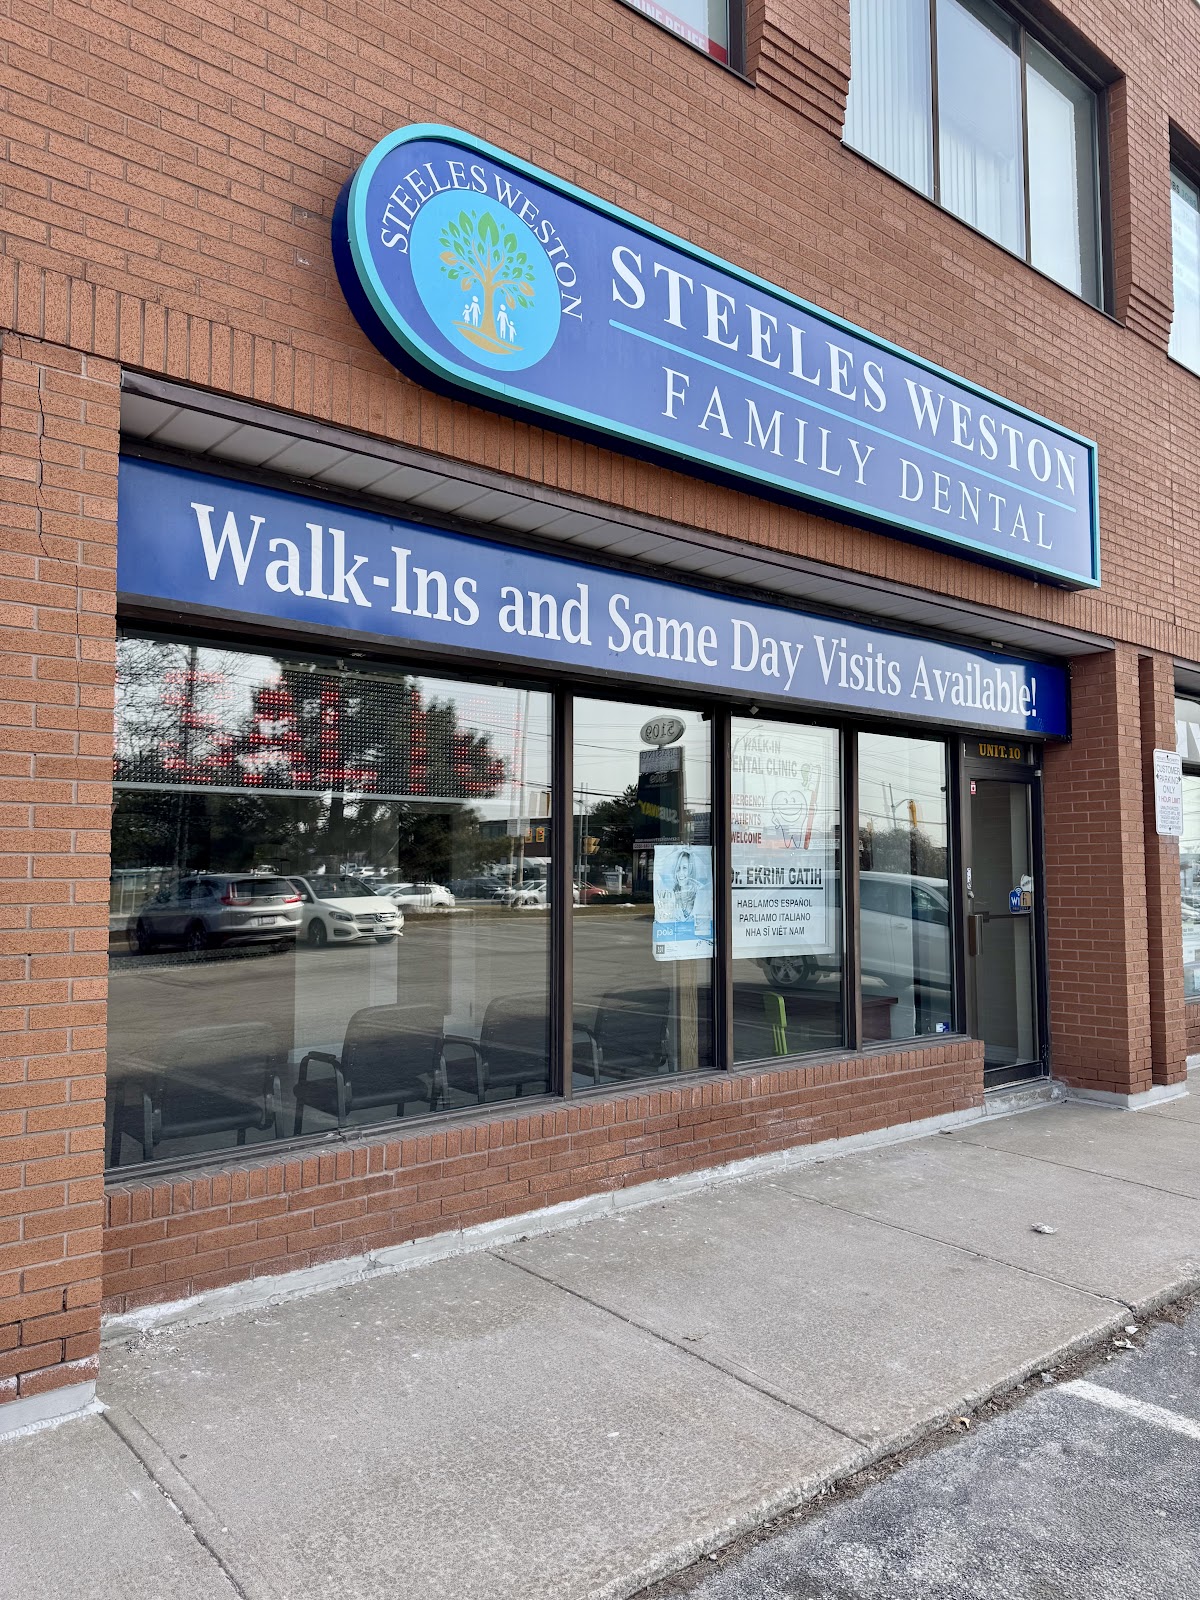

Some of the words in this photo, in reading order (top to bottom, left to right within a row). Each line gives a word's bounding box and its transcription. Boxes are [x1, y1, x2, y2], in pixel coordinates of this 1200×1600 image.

[381, 160, 488, 254] STEELES
[493, 173, 583, 321] WESTON
[611, 245, 887, 413] STEELES
[903, 377, 1076, 497] WESTON
[661, 366, 875, 486] FAMILY
[898, 457, 1053, 550] DENTAL
[190, 502, 480, 626] Walk-Ins
[498, 583, 592, 646] and
[608, 593, 718, 667] Same
[731, 618, 804, 691] Day
[813, 634, 902, 696] Visits
[910, 655, 1037, 717] Available!
[743, 737, 781, 754] WALK-IN
[1009, 747, 1021, 760] 10
[732, 755, 763, 775] ENTAL
[766, 758, 797, 777] CLINIC
[1156, 764, 1180, 776] CUSTOMER
[1159, 775, 1179, 785] PARKING
[1162, 785, 1176, 794] ONLY
[731, 793, 766, 808] MERGENCY
[731, 812, 762, 826] PATIENTS
[731, 831, 762, 844] WELCOME
[746, 867, 785, 885] EKRIM
[788, 867, 822, 885] GATIH
[737, 899, 779, 908] HABLAMOS
[780, 897, 813, 908] ESPAÑOL
[739, 913, 777, 922] PARLIAMO
[779, 912, 811, 922] ITALIANO
[745, 928, 761, 937] NHA
[788, 926, 805, 936] NAM
